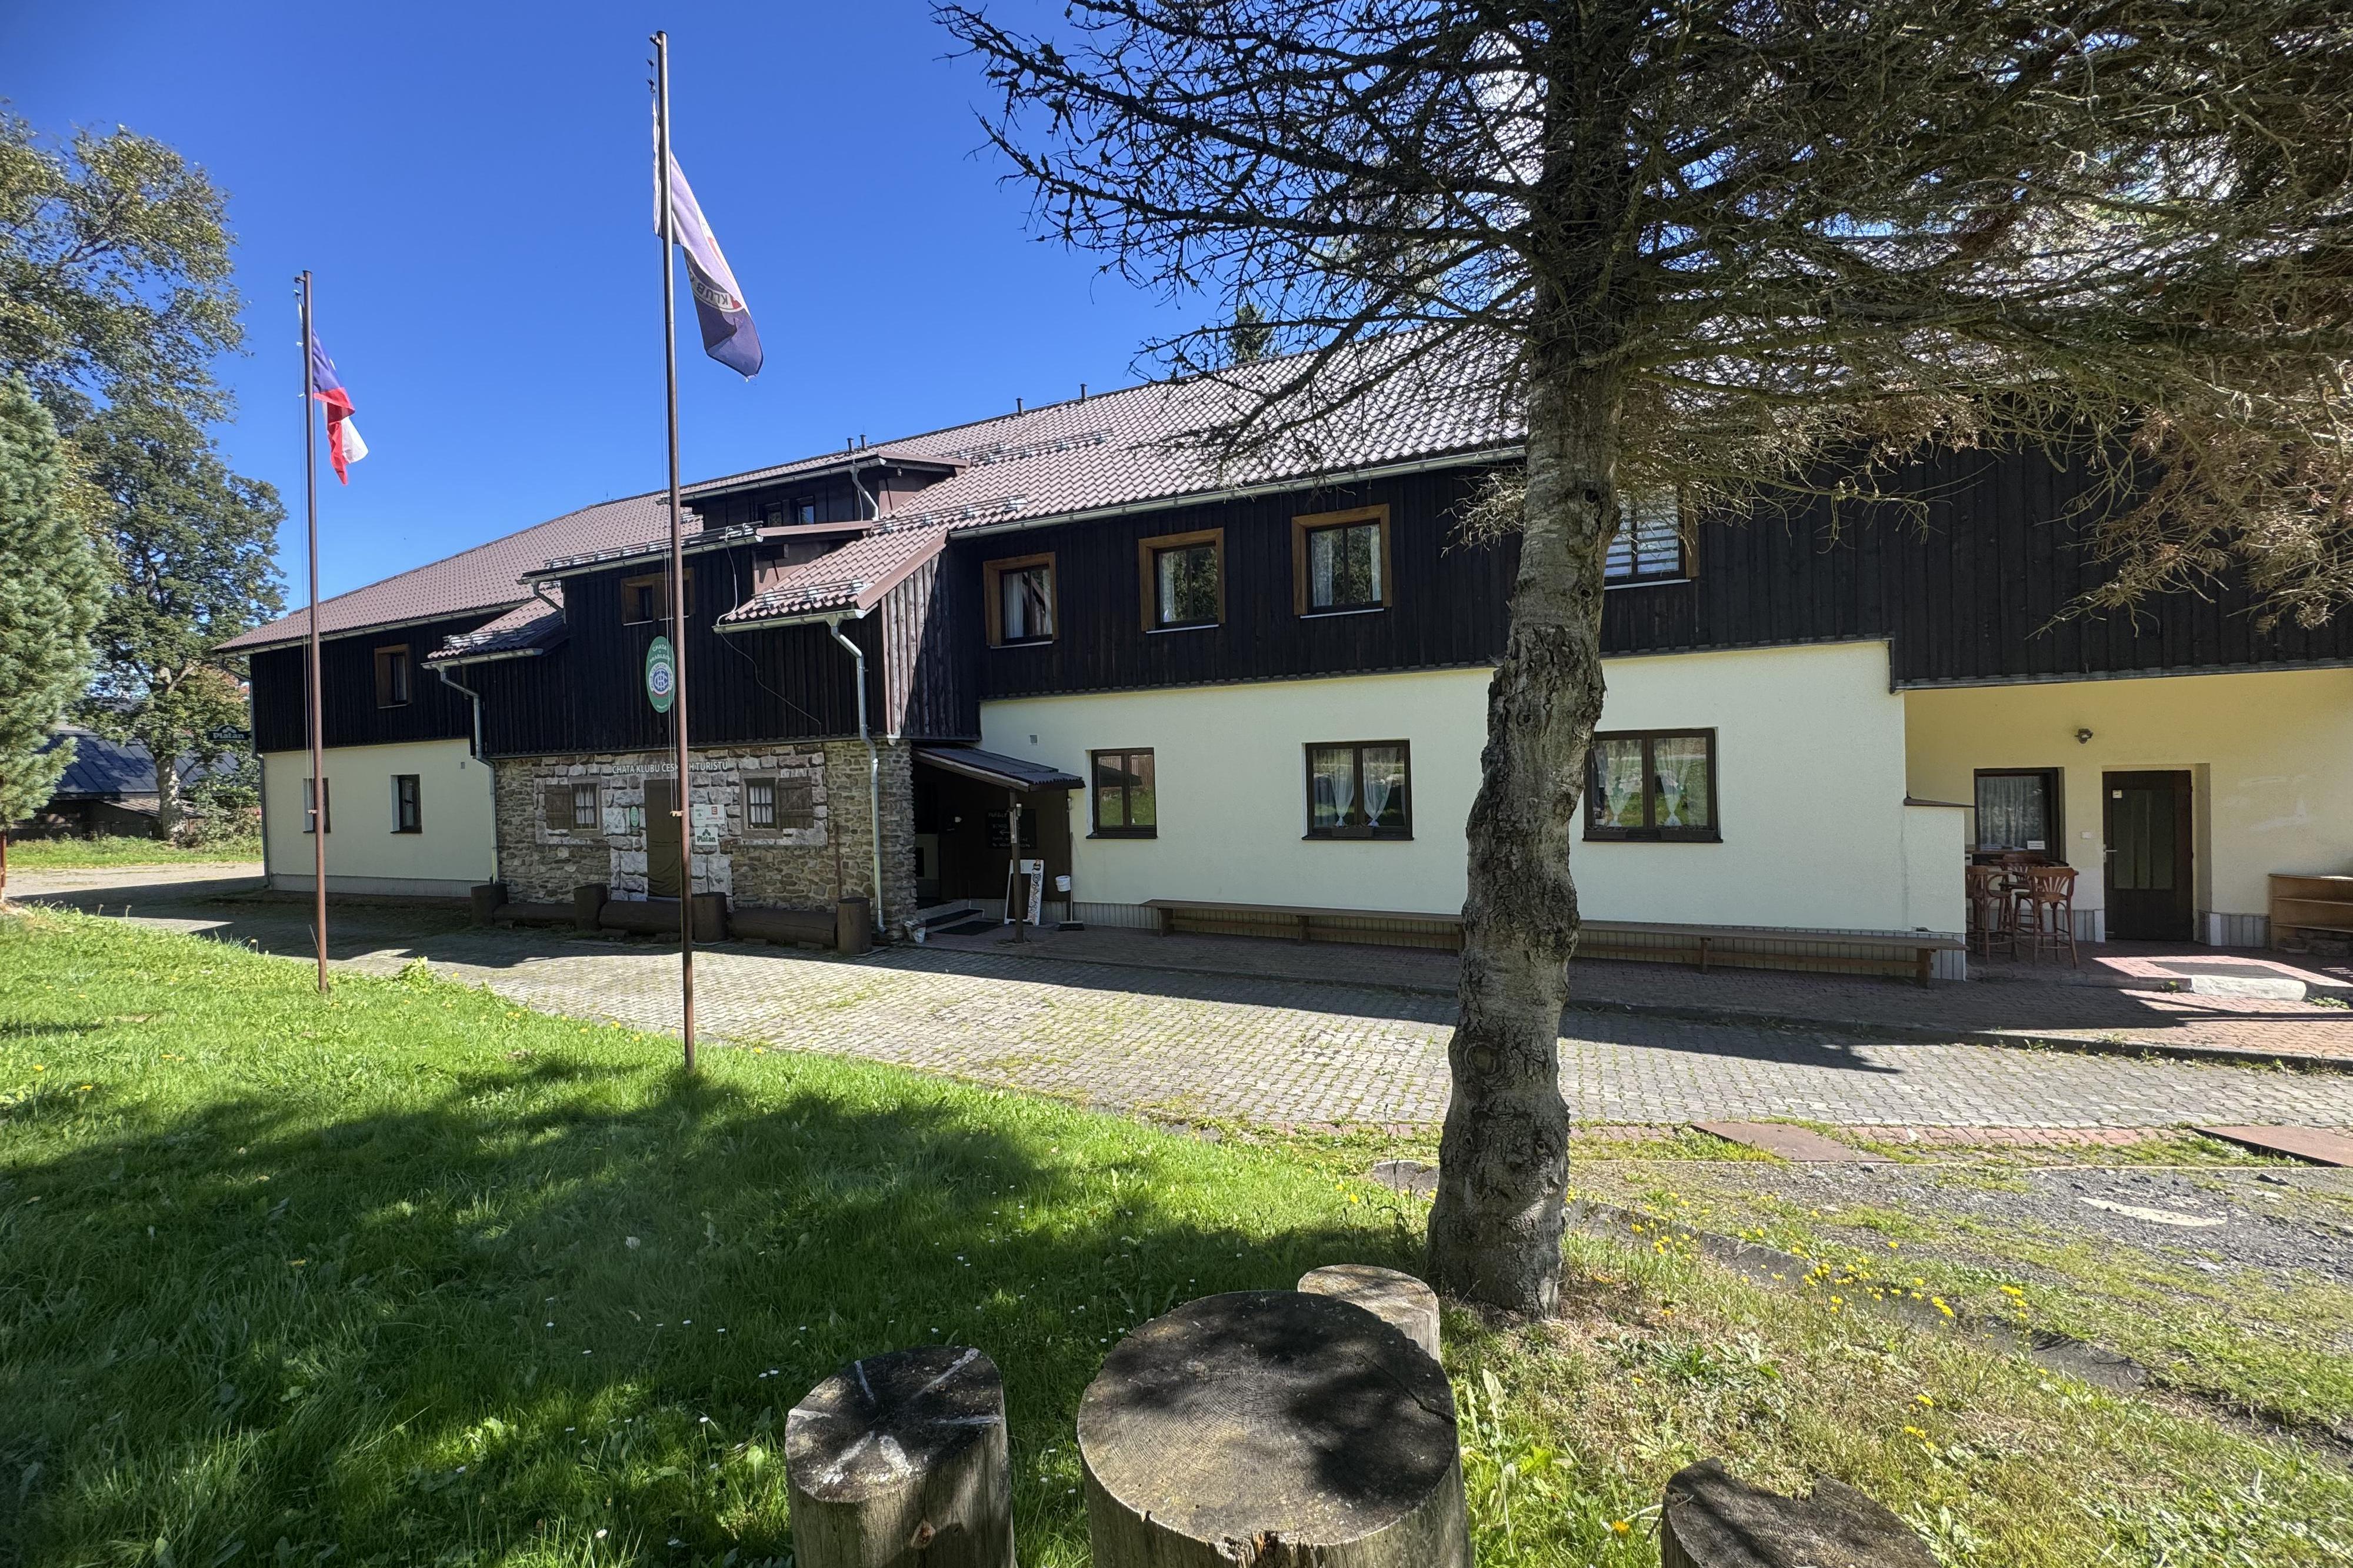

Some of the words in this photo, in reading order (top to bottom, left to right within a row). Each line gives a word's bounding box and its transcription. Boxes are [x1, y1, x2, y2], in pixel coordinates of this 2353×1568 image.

[696, 282, 728, 305] KLUB
[612, 765, 635, 774] CHATA
[636, 764, 660, 773] KLUBU
